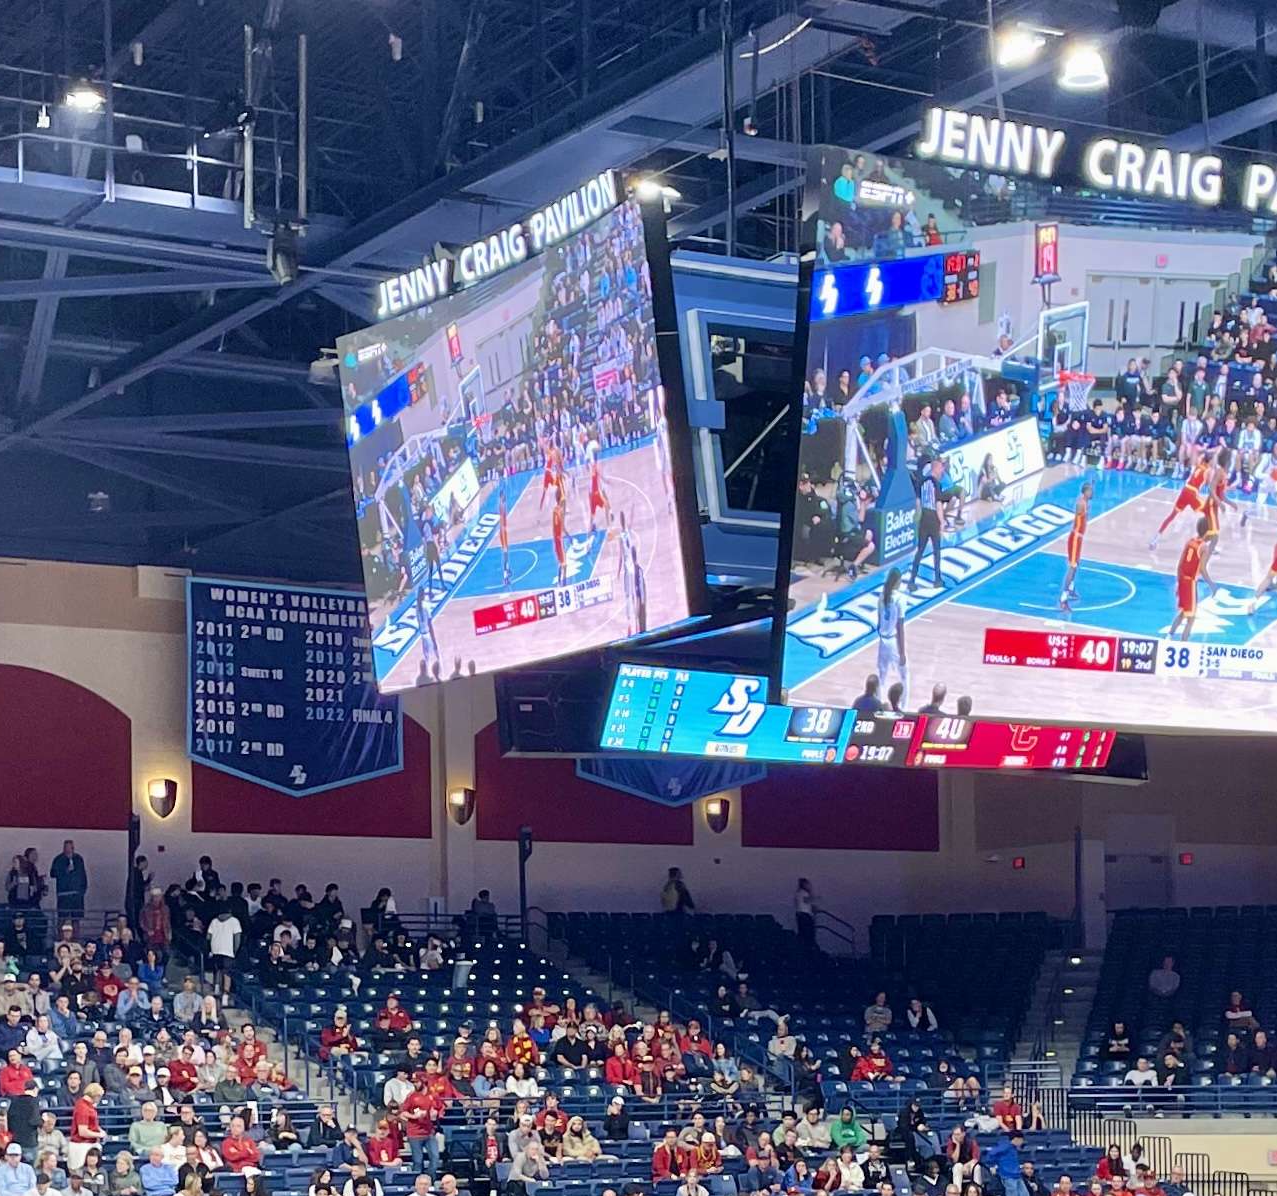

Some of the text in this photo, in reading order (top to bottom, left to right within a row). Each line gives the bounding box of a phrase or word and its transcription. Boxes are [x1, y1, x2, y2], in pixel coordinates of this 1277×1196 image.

[919, 107, 1065, 178] JENNY
[1087, 139, 1222, 201] CRAIG
[377, 168, 617, 315] JENNY CRAIG PAVILION
[885, 507, 916, 531] Baker
[884, 528, 915, 551] Electric
[210, 588, 367, 613] WOMEN'S VOLLEYBA
[558, 591, 570, 608] 38
[225, 605, 366, 627] NCAA TOURNAMENT
[196, 621, 233, 637] 2011
[267, 627, 284, 641] RD
[196, 641, 234, 657] 2012
[1048, 635, 1264, 668] USC 40 19:07 38 SAN DIEGO
[196, 660, 234, 676] 2013
[1135, 659, 1152, 670] 2nd
[305, 669, 346, 684] 2020
[196, 680, 235, 695] 2014
[305, 688, 344, 702] 2021
[196, 699, 236, 715] 2015
[267, 704, 285, 718] RD
[305, 707, 393, 724] 2022 FINAL 4
[196, 719, 235, 734] 2016
[802, 708, 832, 734] 38
[854, 720, 874, 734] 2ND
[196, 738, 233, 753] 2017
[267, 742, 284, 757] RD
[860, 745, 894, 761] 19:07
